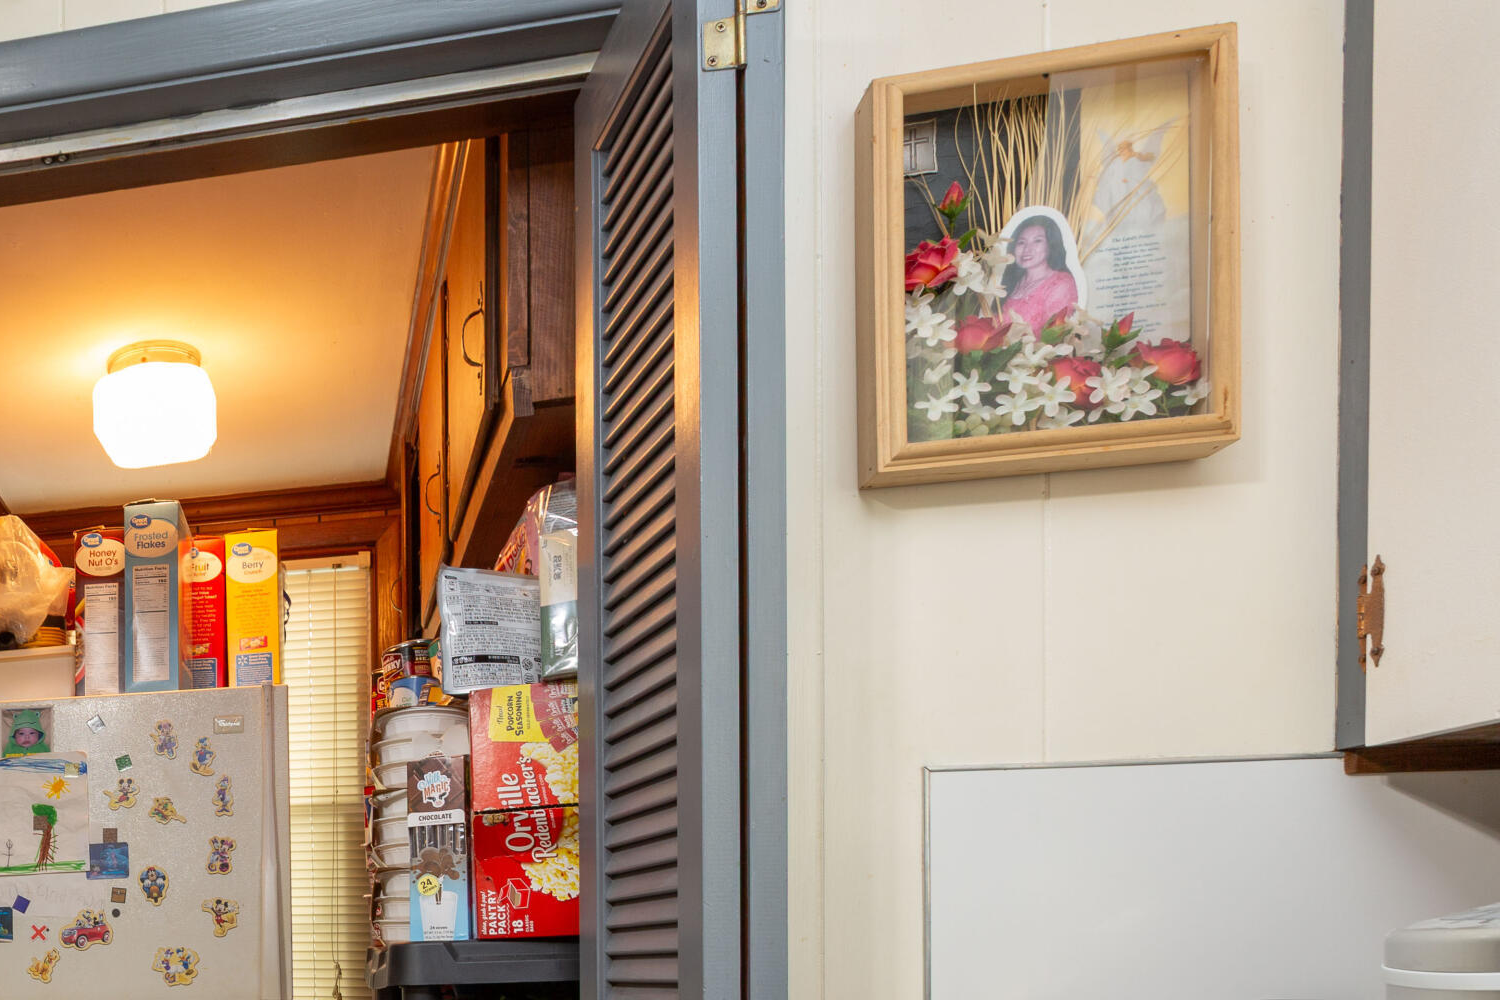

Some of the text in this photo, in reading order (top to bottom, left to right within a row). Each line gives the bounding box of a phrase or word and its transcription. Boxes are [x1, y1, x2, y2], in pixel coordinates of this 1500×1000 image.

[134, 531, 168, 541] Frosted
[136, 540, 166, 549] Flakes
[89, 549, 117, 558] Honey
[88, 557, 119, 567] Nut O's
[506, 695, 515, 732] POPCORN
[514, 690, 524, 736] SEASONING
[418, 812, 452, 822] CHOCOLATE
[420, 877, 432, 889] 24
[487, 889, 498, 935] PANTRY
[497, 904, 507, 935] PACK
[511, 919, 524, 933] 18
